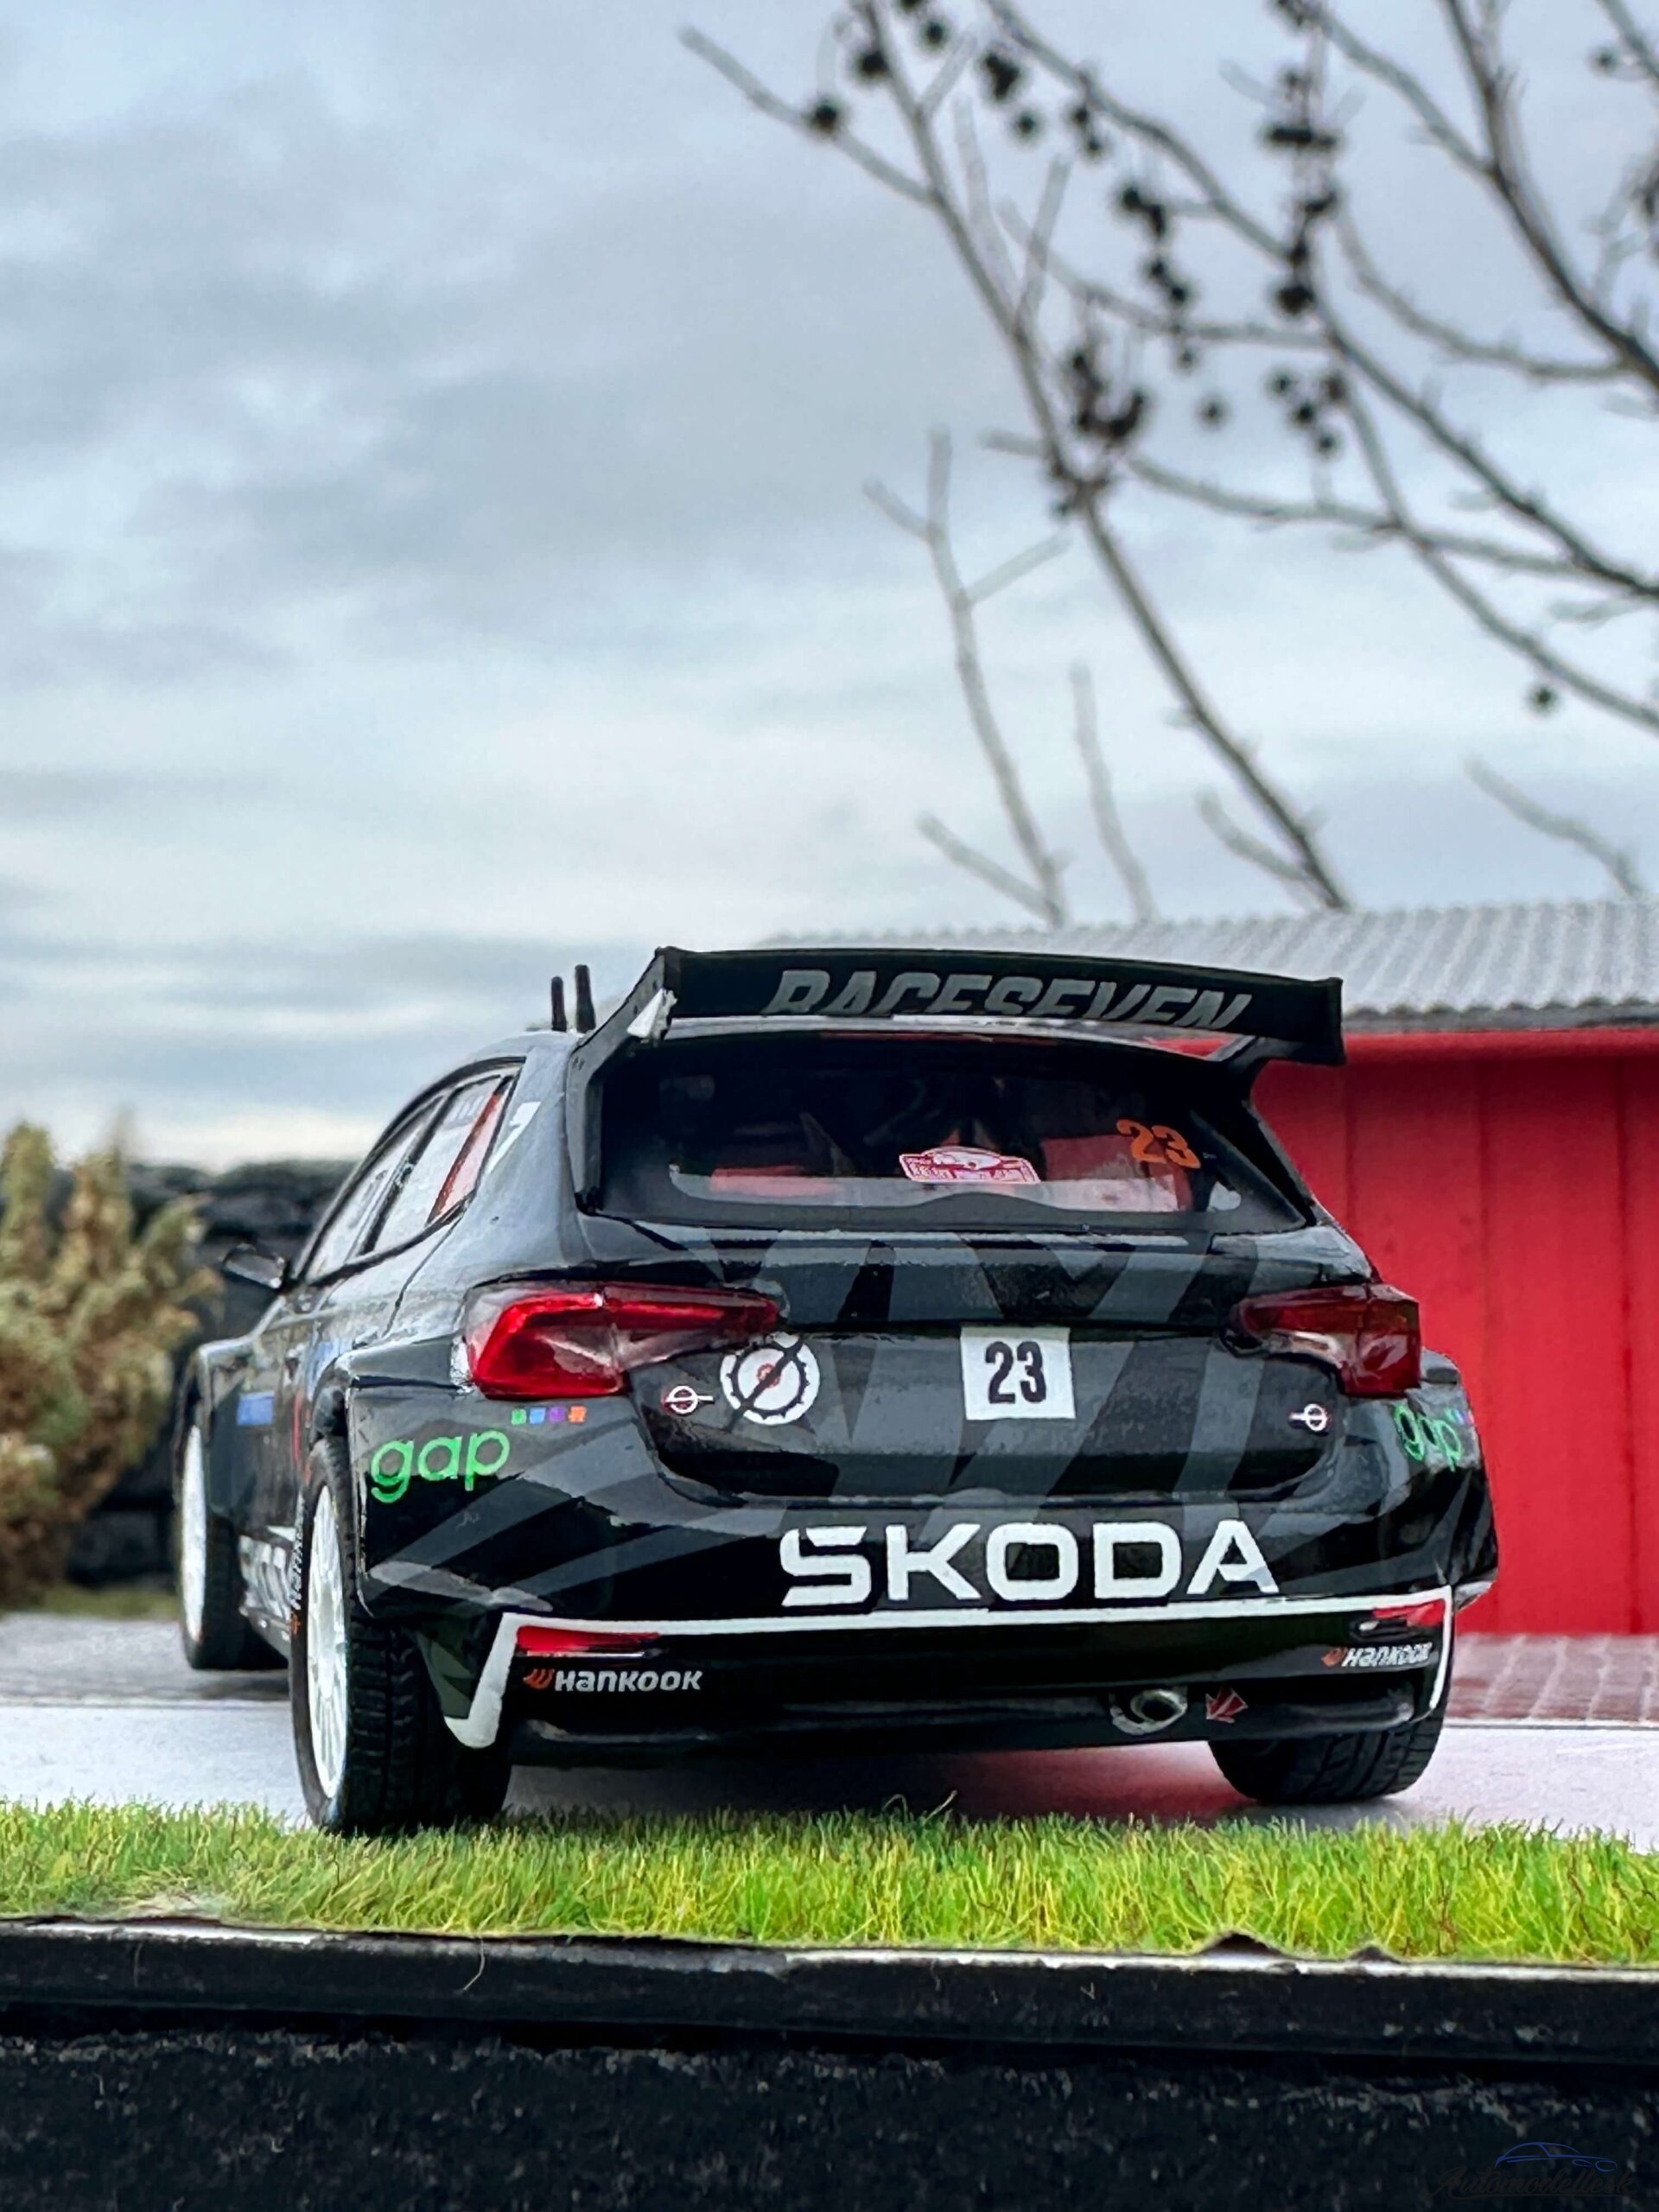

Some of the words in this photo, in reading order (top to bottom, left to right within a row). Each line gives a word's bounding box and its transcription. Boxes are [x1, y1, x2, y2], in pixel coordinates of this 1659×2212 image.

[1116, 1119, 1201, 1169] 23
[985, 1341, 1047, 1404] 23
[371, 1429, 511, 1503] gap
[779, 1519, 1280, 1607] SKODA
